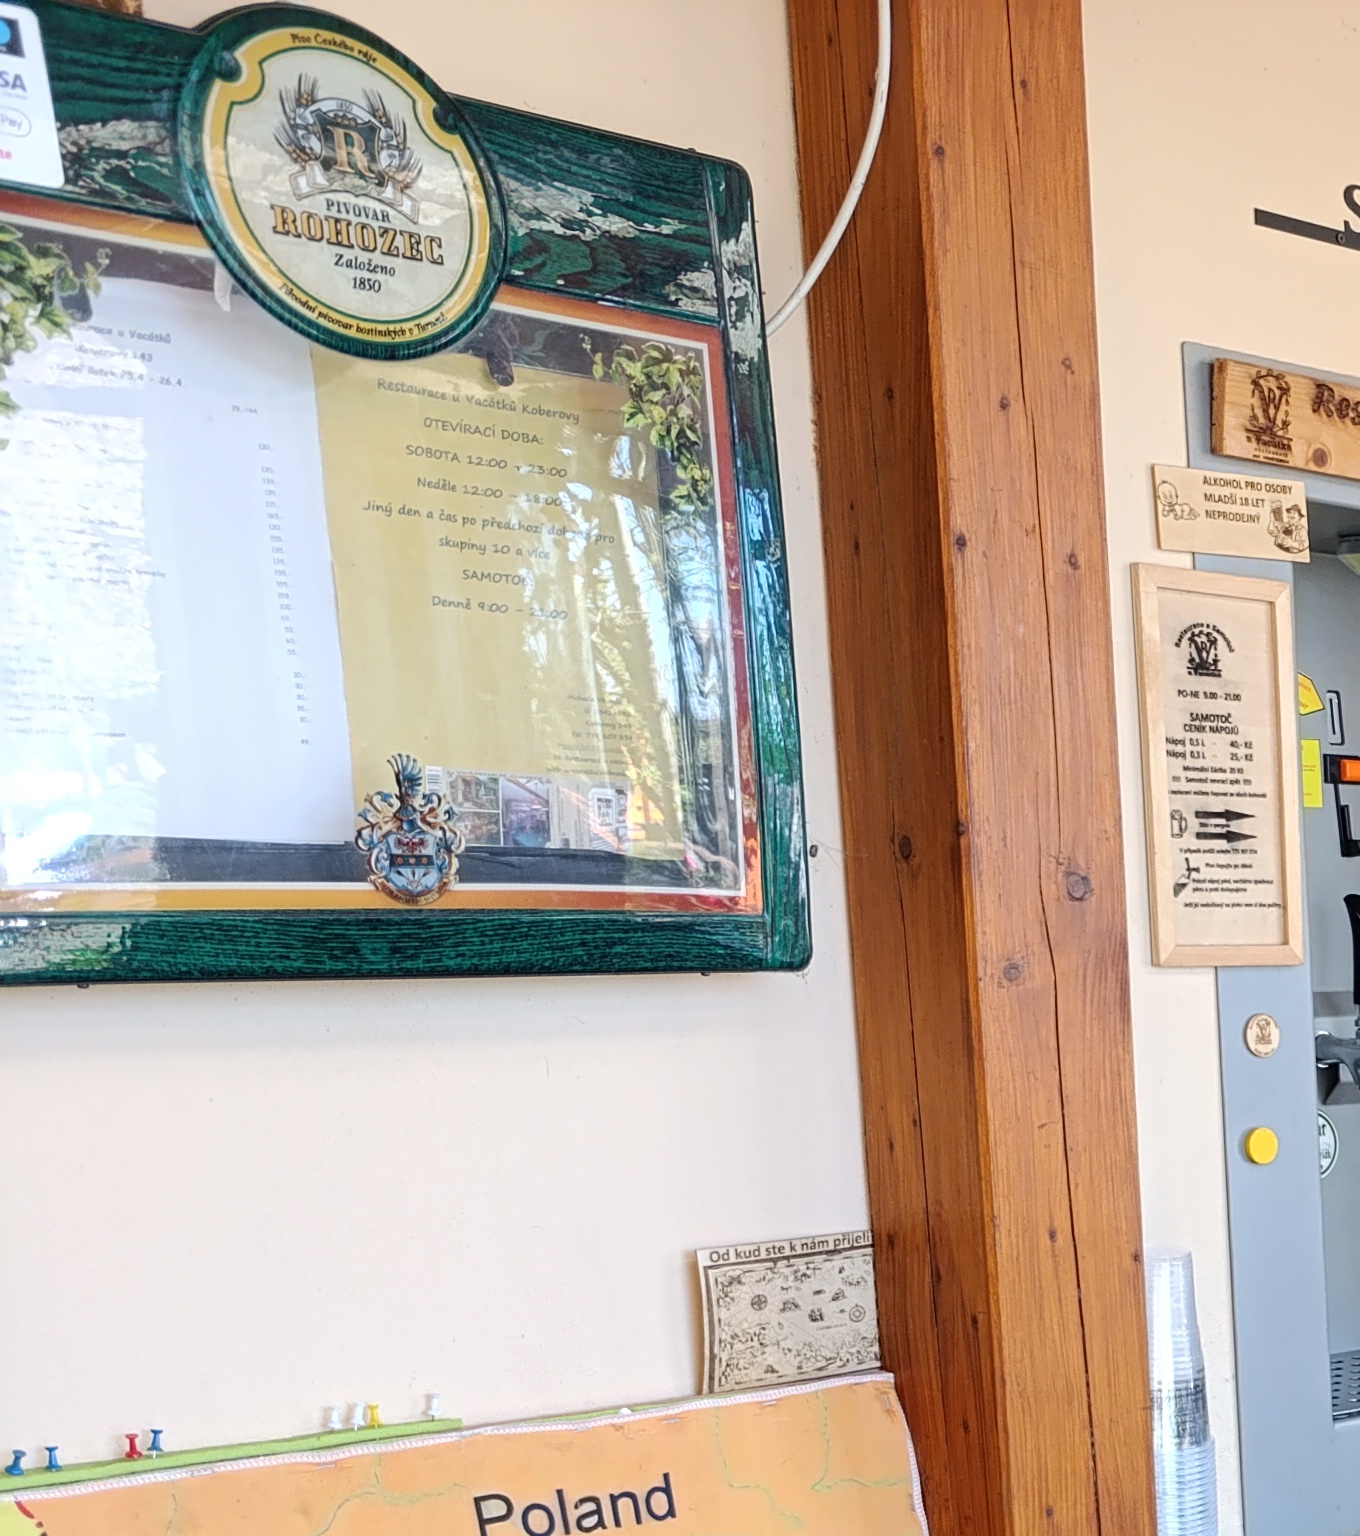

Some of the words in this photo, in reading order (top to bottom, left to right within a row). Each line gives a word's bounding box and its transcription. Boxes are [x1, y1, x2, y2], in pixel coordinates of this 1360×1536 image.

[327, 125, 379, 179] R
[325, 199, 391, 223] PIVOVAR
[271, 203, 444, 265] ROHOZEC
[334, 253, 396, 277] Založeno
[352, 276, 381, 293] 1850
[317, 310, 353, 332] pivovar
[377, 378, 447, 400] Restaurace
[452, 393, 460, 402] u
[465, 393, 516, 412] Vacátků
[522, 403, 580, 425] Koberovy
[423, 417, 496, 438] OTEVÍRACÍ
[501, 428, 544, 445] DOBA:
[406, 444, 461, 463] SOBOTA
[466, 455, 508, 469] 12:00
[527, 463, 568, 478] 23:00
[417, 477, 457, 493] Neděle
[462, 484, 503, 499] 12:00
[525, 492, 562, 507] 18:00
[1202, 475, 1243, 490] ALKOHOL
[1245, 481, 1262, 491] PRO
[1265, 482, 1293, 495] OSOBY
[1204, 492, 1237, 505] MLADŠÍ
[1240, 497, 1249, 506] 18
[1251, 498, 1265, 508] LET
[362, 500, 392, 518] Jiný
[398, 503, 421, 518] den
[426, 510, 434, 520] a
[438, 509, 457, 523] čas
[462, 515, 477, 529] po
[482, 516, 542, 535] předchozí
[594, 532, 615, 545] pro
[1205, 510, 1260, 524] NEPRODEJNÝ
[439, 536, 486, 556] skupiny
[492, 545, 510, 555] 10
[516, 547, 523, 556] a
[432, 595, 471, 610] Denně
[478, 602, 509, 615] 9:00
[1177, 689, 1200, 699] PO-NE
[1189, 712, 1233, 724] SAMOTOČ
[1183, 722, 1208, 734] CENÍK
[1209, 723, 1239, 736] NÁPOJŮ
[1165, 736, 1187, 748] Nápoj
[1189, 738, 1200, 748] 0,5
[1166, 749, 1187, 761] Nápoj
[709, 1249, 730, 1263] Od
[735, 1245, 761, 1260] kud
[765, 1245, 786, 1256] ste
[790, 1241, 798, 1253] k
[801, 1238, 830, 1251] nám
[833, 1231, 871, 1251] přijeli
